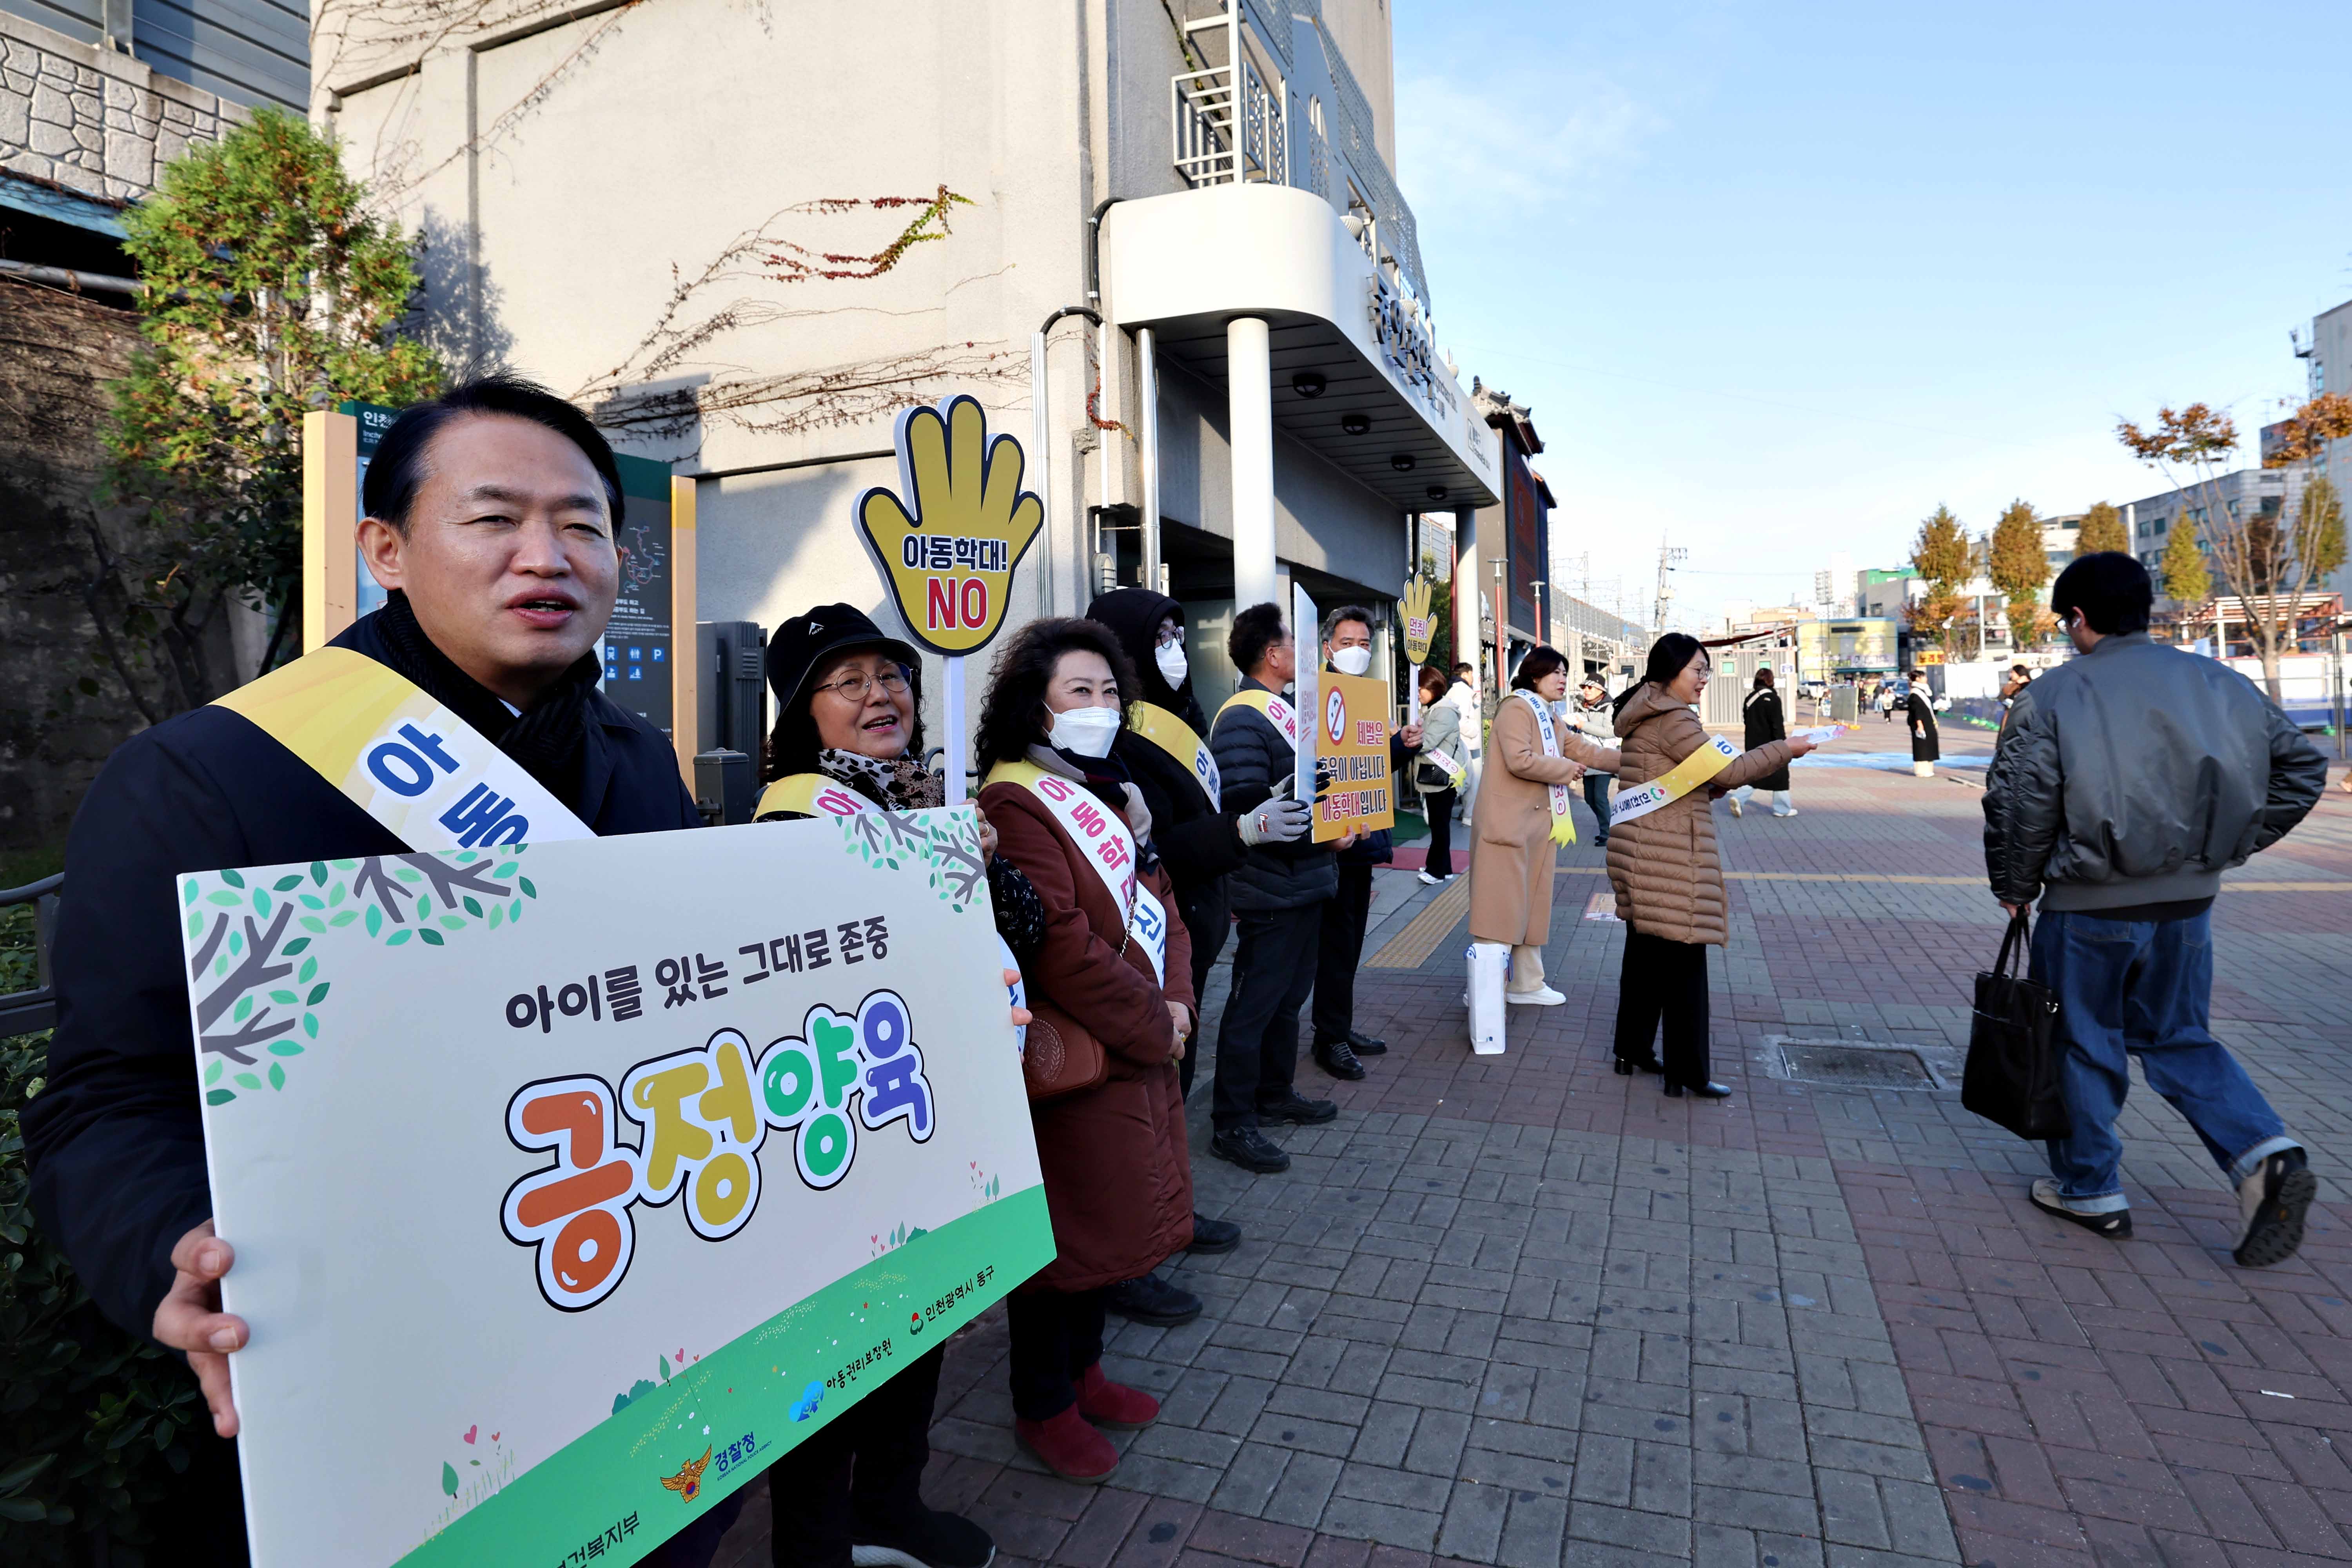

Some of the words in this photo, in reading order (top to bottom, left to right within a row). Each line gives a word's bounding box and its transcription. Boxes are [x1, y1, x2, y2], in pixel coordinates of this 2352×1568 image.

[903, 534, 1008, 572] 아동학대!
[927, 577, 988, 630] NO
[1407, 639, 1427, 653] 아동학대
[1409, 617, 1428, 639] 멈춰!
[653, 649, 662, 660] P
[1356, 720, 1384, 745] 체벌은
[1350, 755, 1385, 780] 아닙니다
[1322, 789, 1387, 822] 아동학대입니다
[505, 964, 644, 1034] 아이를
[655, 952, 729, 1010] 있는
[739, 928, 832, 985] 그대로
[837, 915, 889, 965] 존중
[508, 994, 932, 1303] 긍정양육
[926, 1278, 975, 1323] 인천광역시
[976, 1265, 995, 1287] 동구
[826, 1338, 893, 1389] 아동권리보장원
[714, 1431, 755, 1472] 경찰청
[717, 1470, 731, 1481] KOREAN
[731, 1457, 748, 1472] NATIONAL
[748, 1450, 759, 1461] POLICE
[759, 1440, 772, 1452] AGENCY
